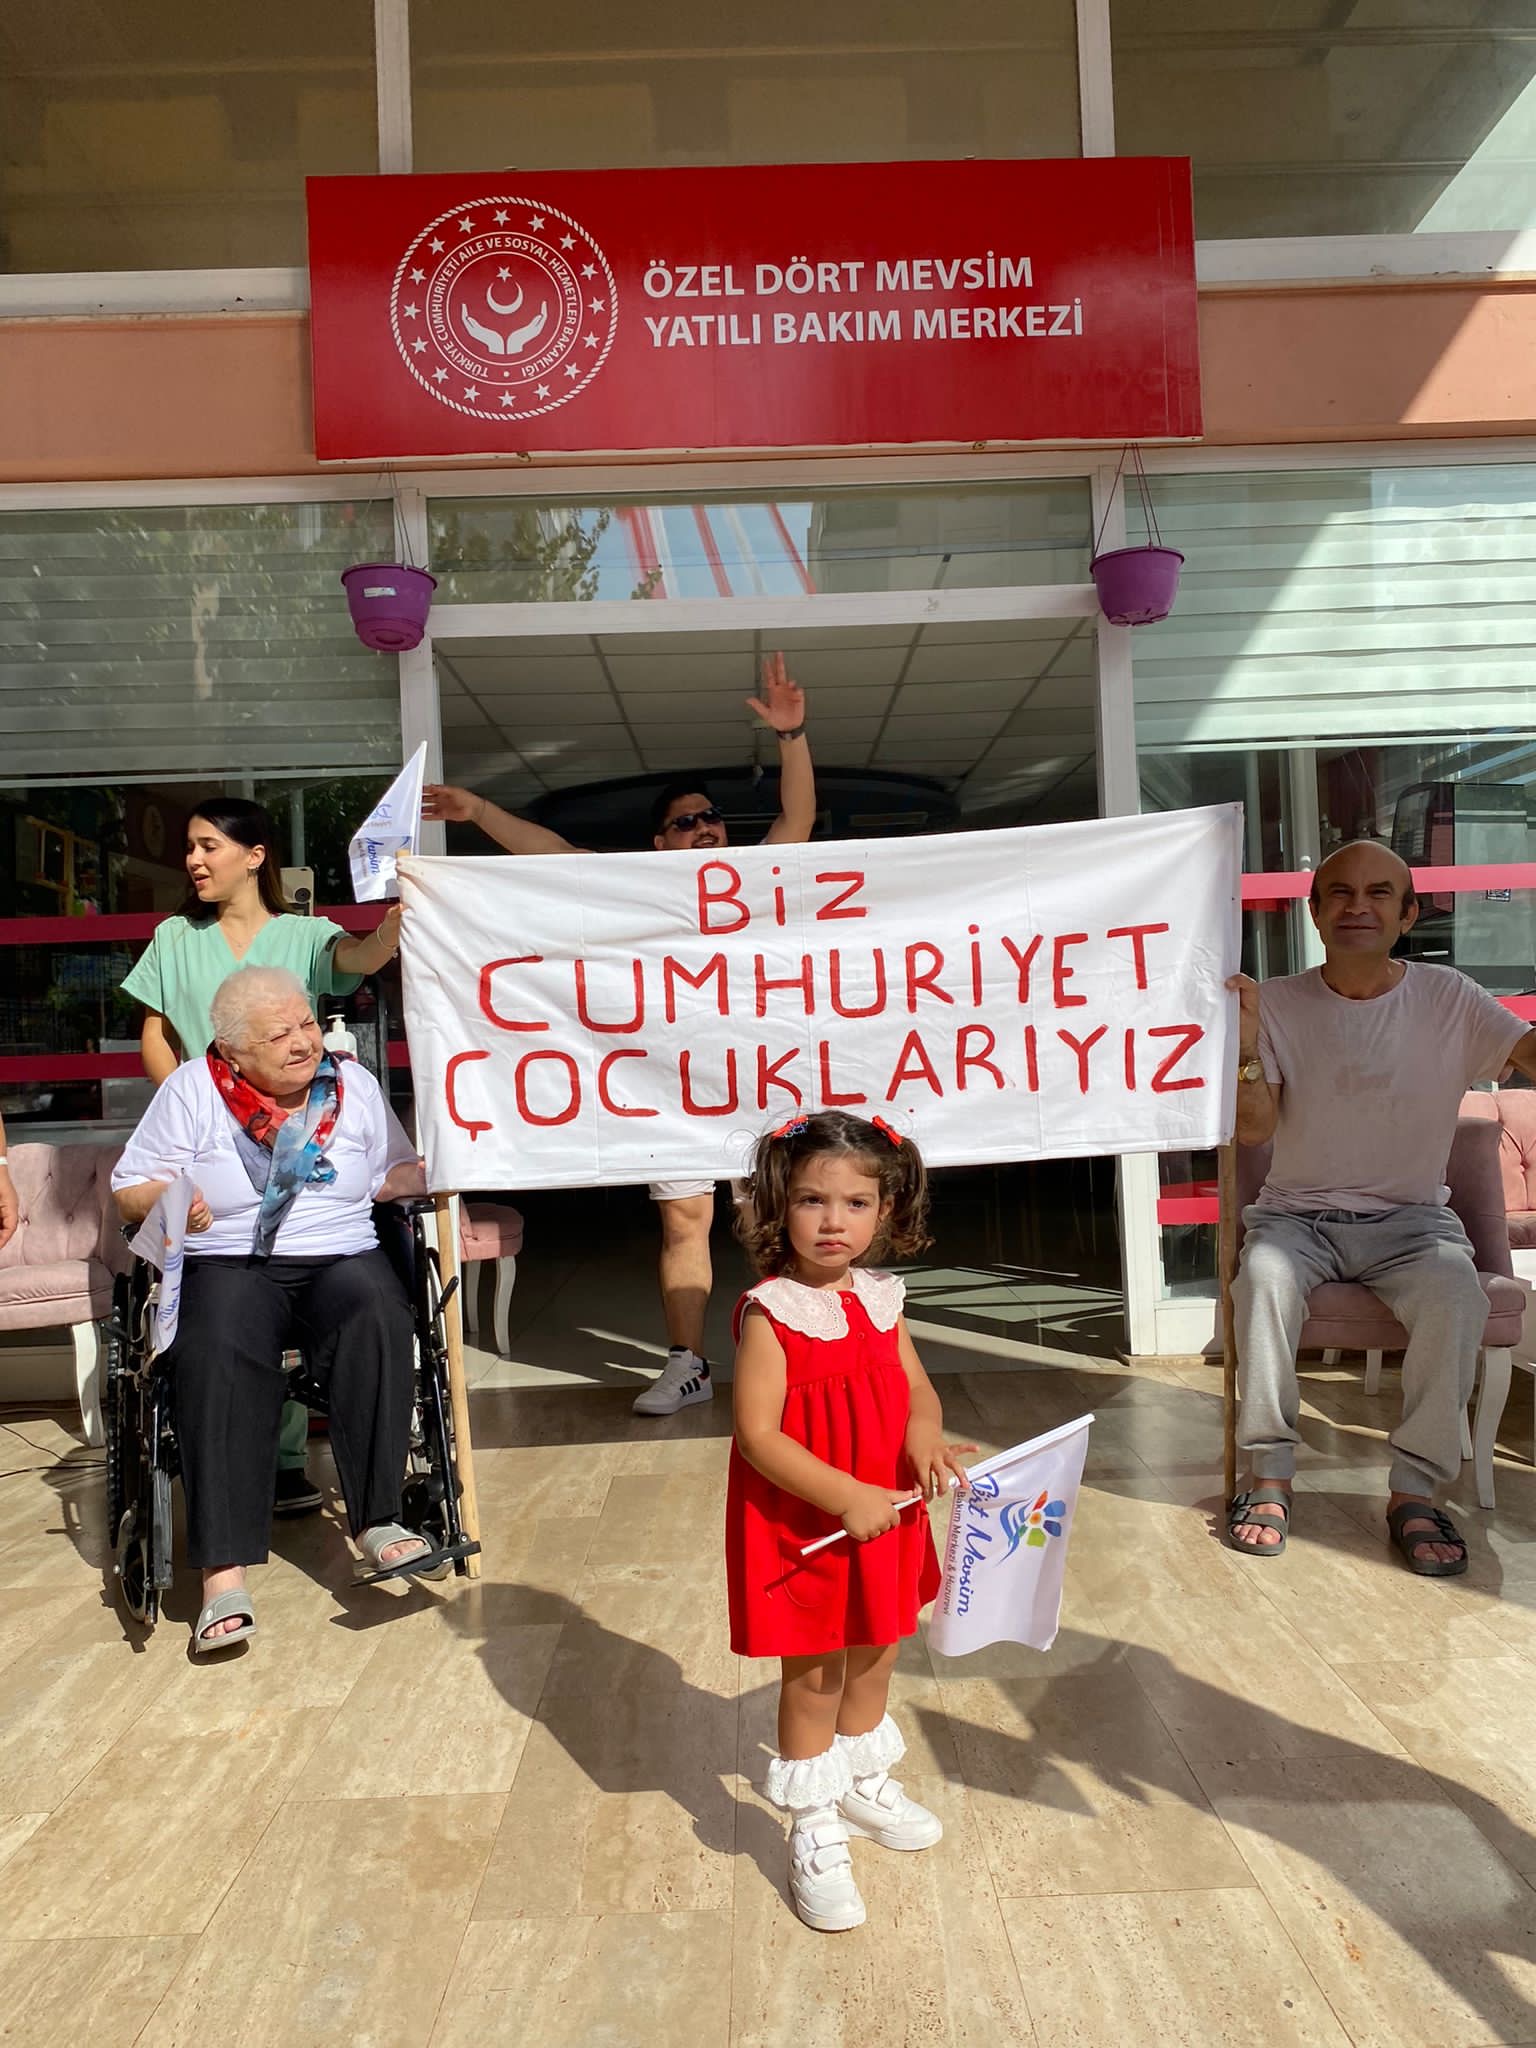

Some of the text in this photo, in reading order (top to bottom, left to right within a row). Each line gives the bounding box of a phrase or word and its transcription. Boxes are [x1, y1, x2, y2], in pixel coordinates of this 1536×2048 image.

[431, 236, 577, 378] TÜRKİYE CUMHURİYETİ AİLE VE SOSYAL HİZMETLER BAKANLIĞI
[643, 250, 1034, 298] ÖZEL DÖRT MEVSİM
[643, 297, 1087, 349] YATILI BAKIM MERKEZİ
[480, 923, 1169, 1034] CUMHURİYET
[446, 1024, 1207, 1141] ÇOCUKLARIYIZ
[949, 1524, 962, 1563] Merkezi
[957, 1523, 992, 1617] Mevsim
